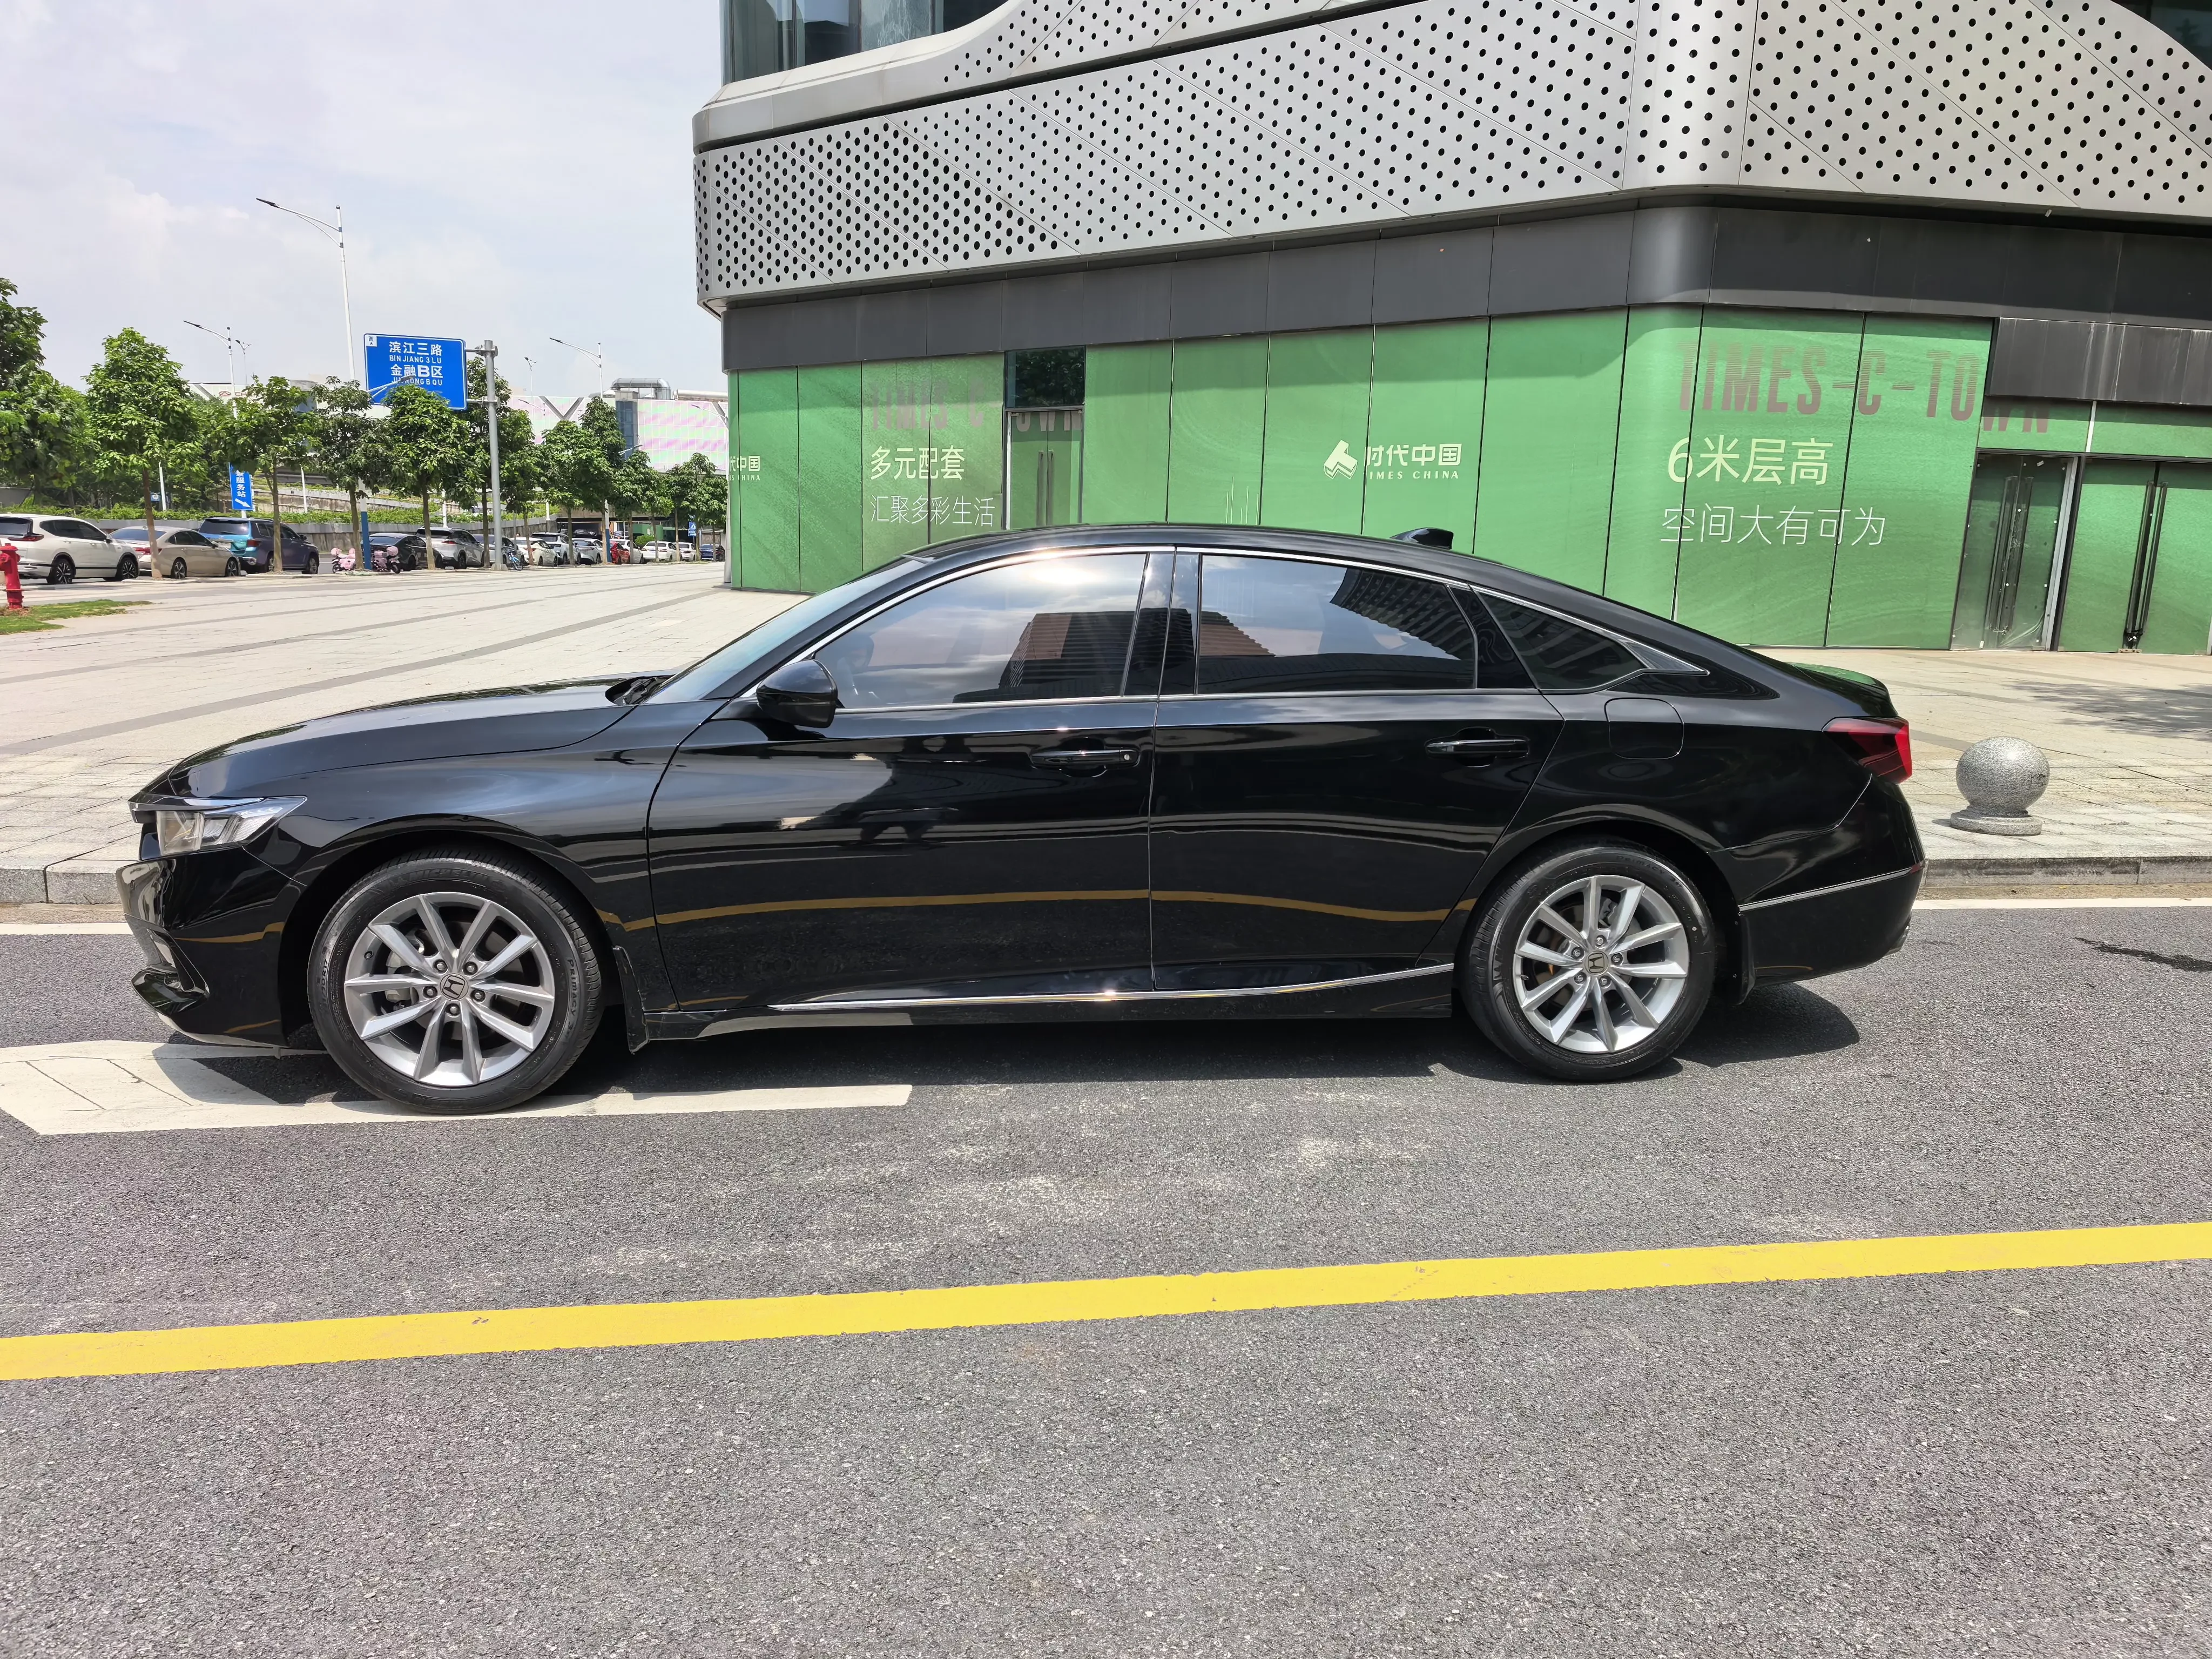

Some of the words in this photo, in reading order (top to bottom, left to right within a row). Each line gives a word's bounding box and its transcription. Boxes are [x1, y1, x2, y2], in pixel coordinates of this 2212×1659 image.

[389, 341, 442, 356] 滨江三路
[390, 363, 443, 378] 金融B区
[871, 445, 965, 480] 多元配套
[1364, 443, 1462, 467] 时代中国
[1668, 434, 1834, 485] 6米层高
[1363, 471, 1403, 480] IMES
[1413, 470, 1459, 480] CHINA
[870, 495, 995, 527] 汇聚多彩生活
[1660, 503, 1885, 545] 空间大有可为
[565, 957, 577, 1016] PRIMACY
